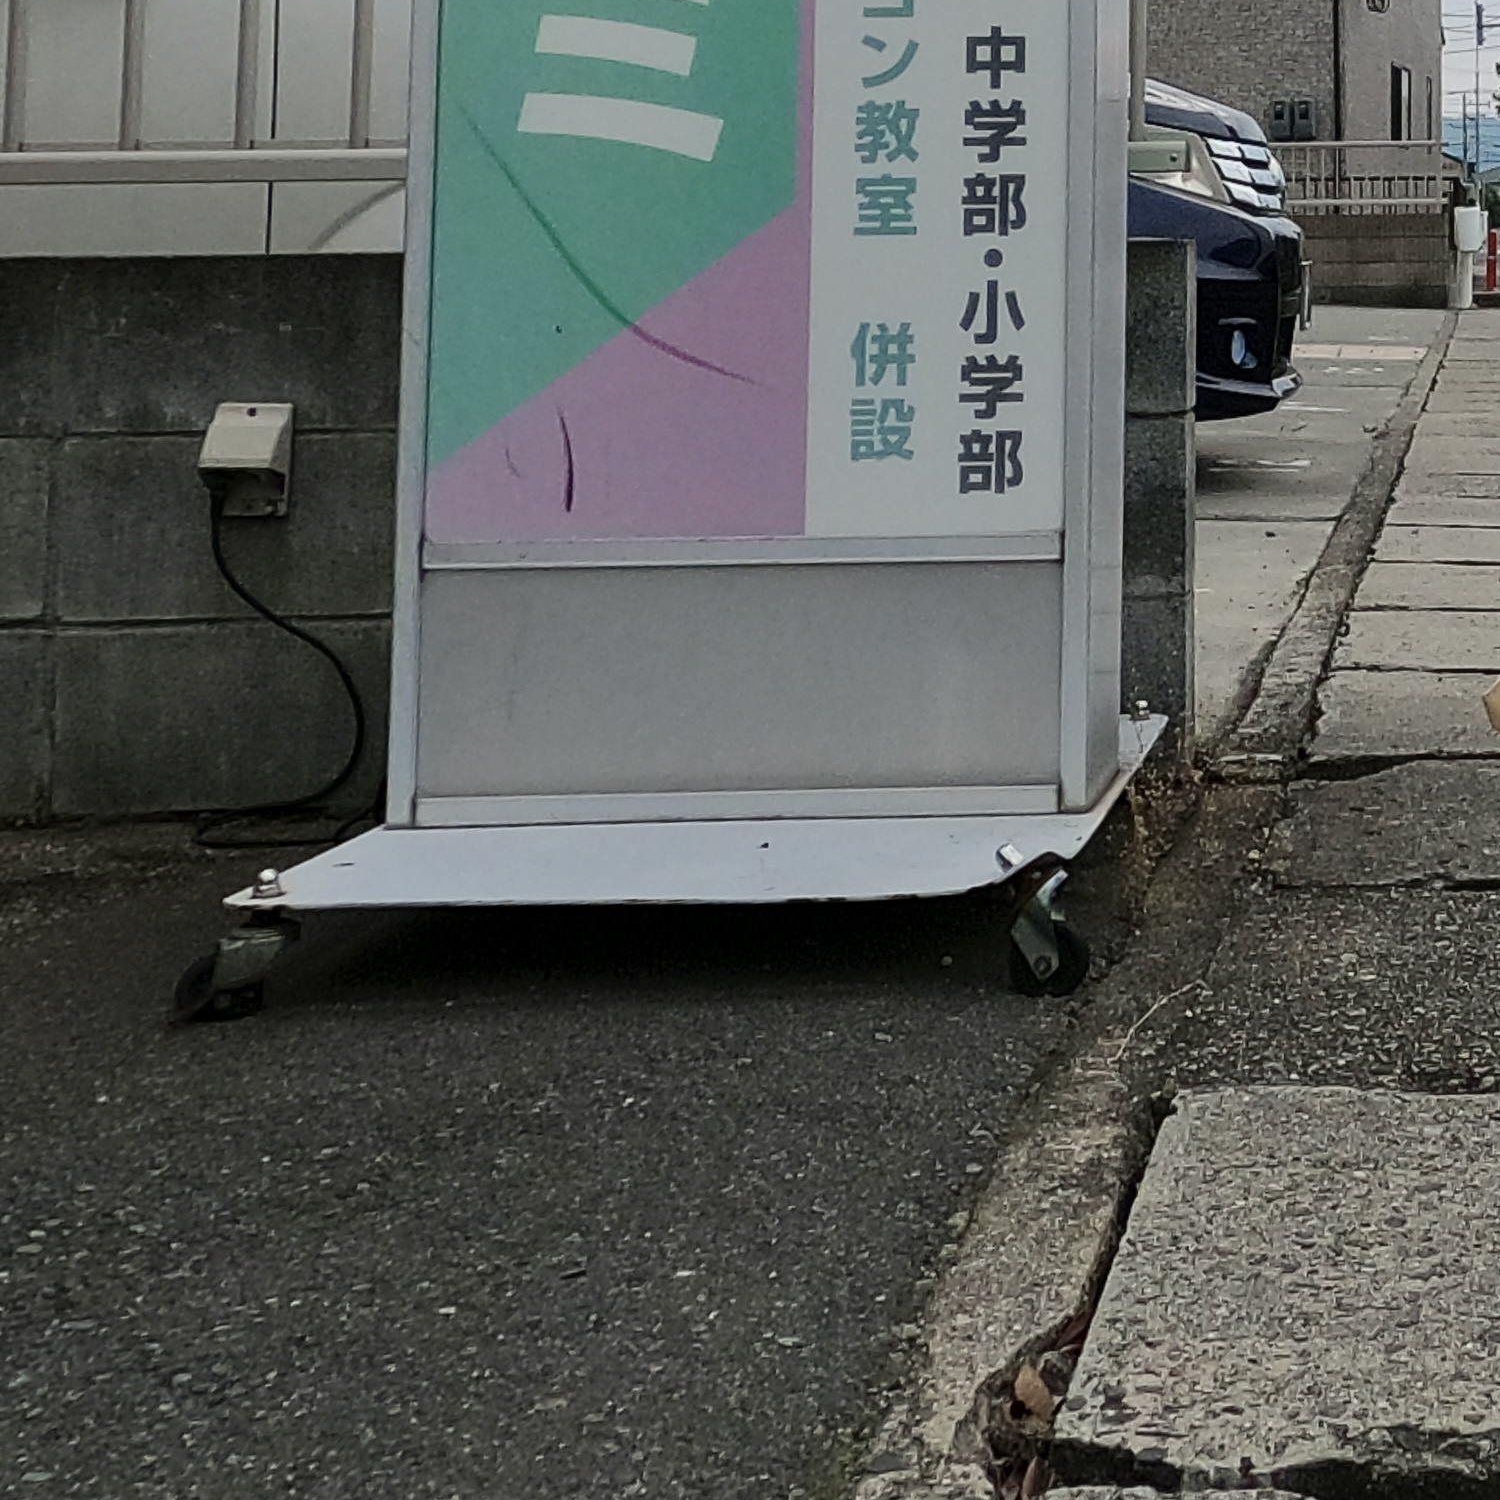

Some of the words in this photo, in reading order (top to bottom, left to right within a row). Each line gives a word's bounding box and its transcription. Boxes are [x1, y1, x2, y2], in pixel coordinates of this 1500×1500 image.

[849, 322, 916, 462] 併設
[957, 25, 1027, 496] 中学部・小学部
